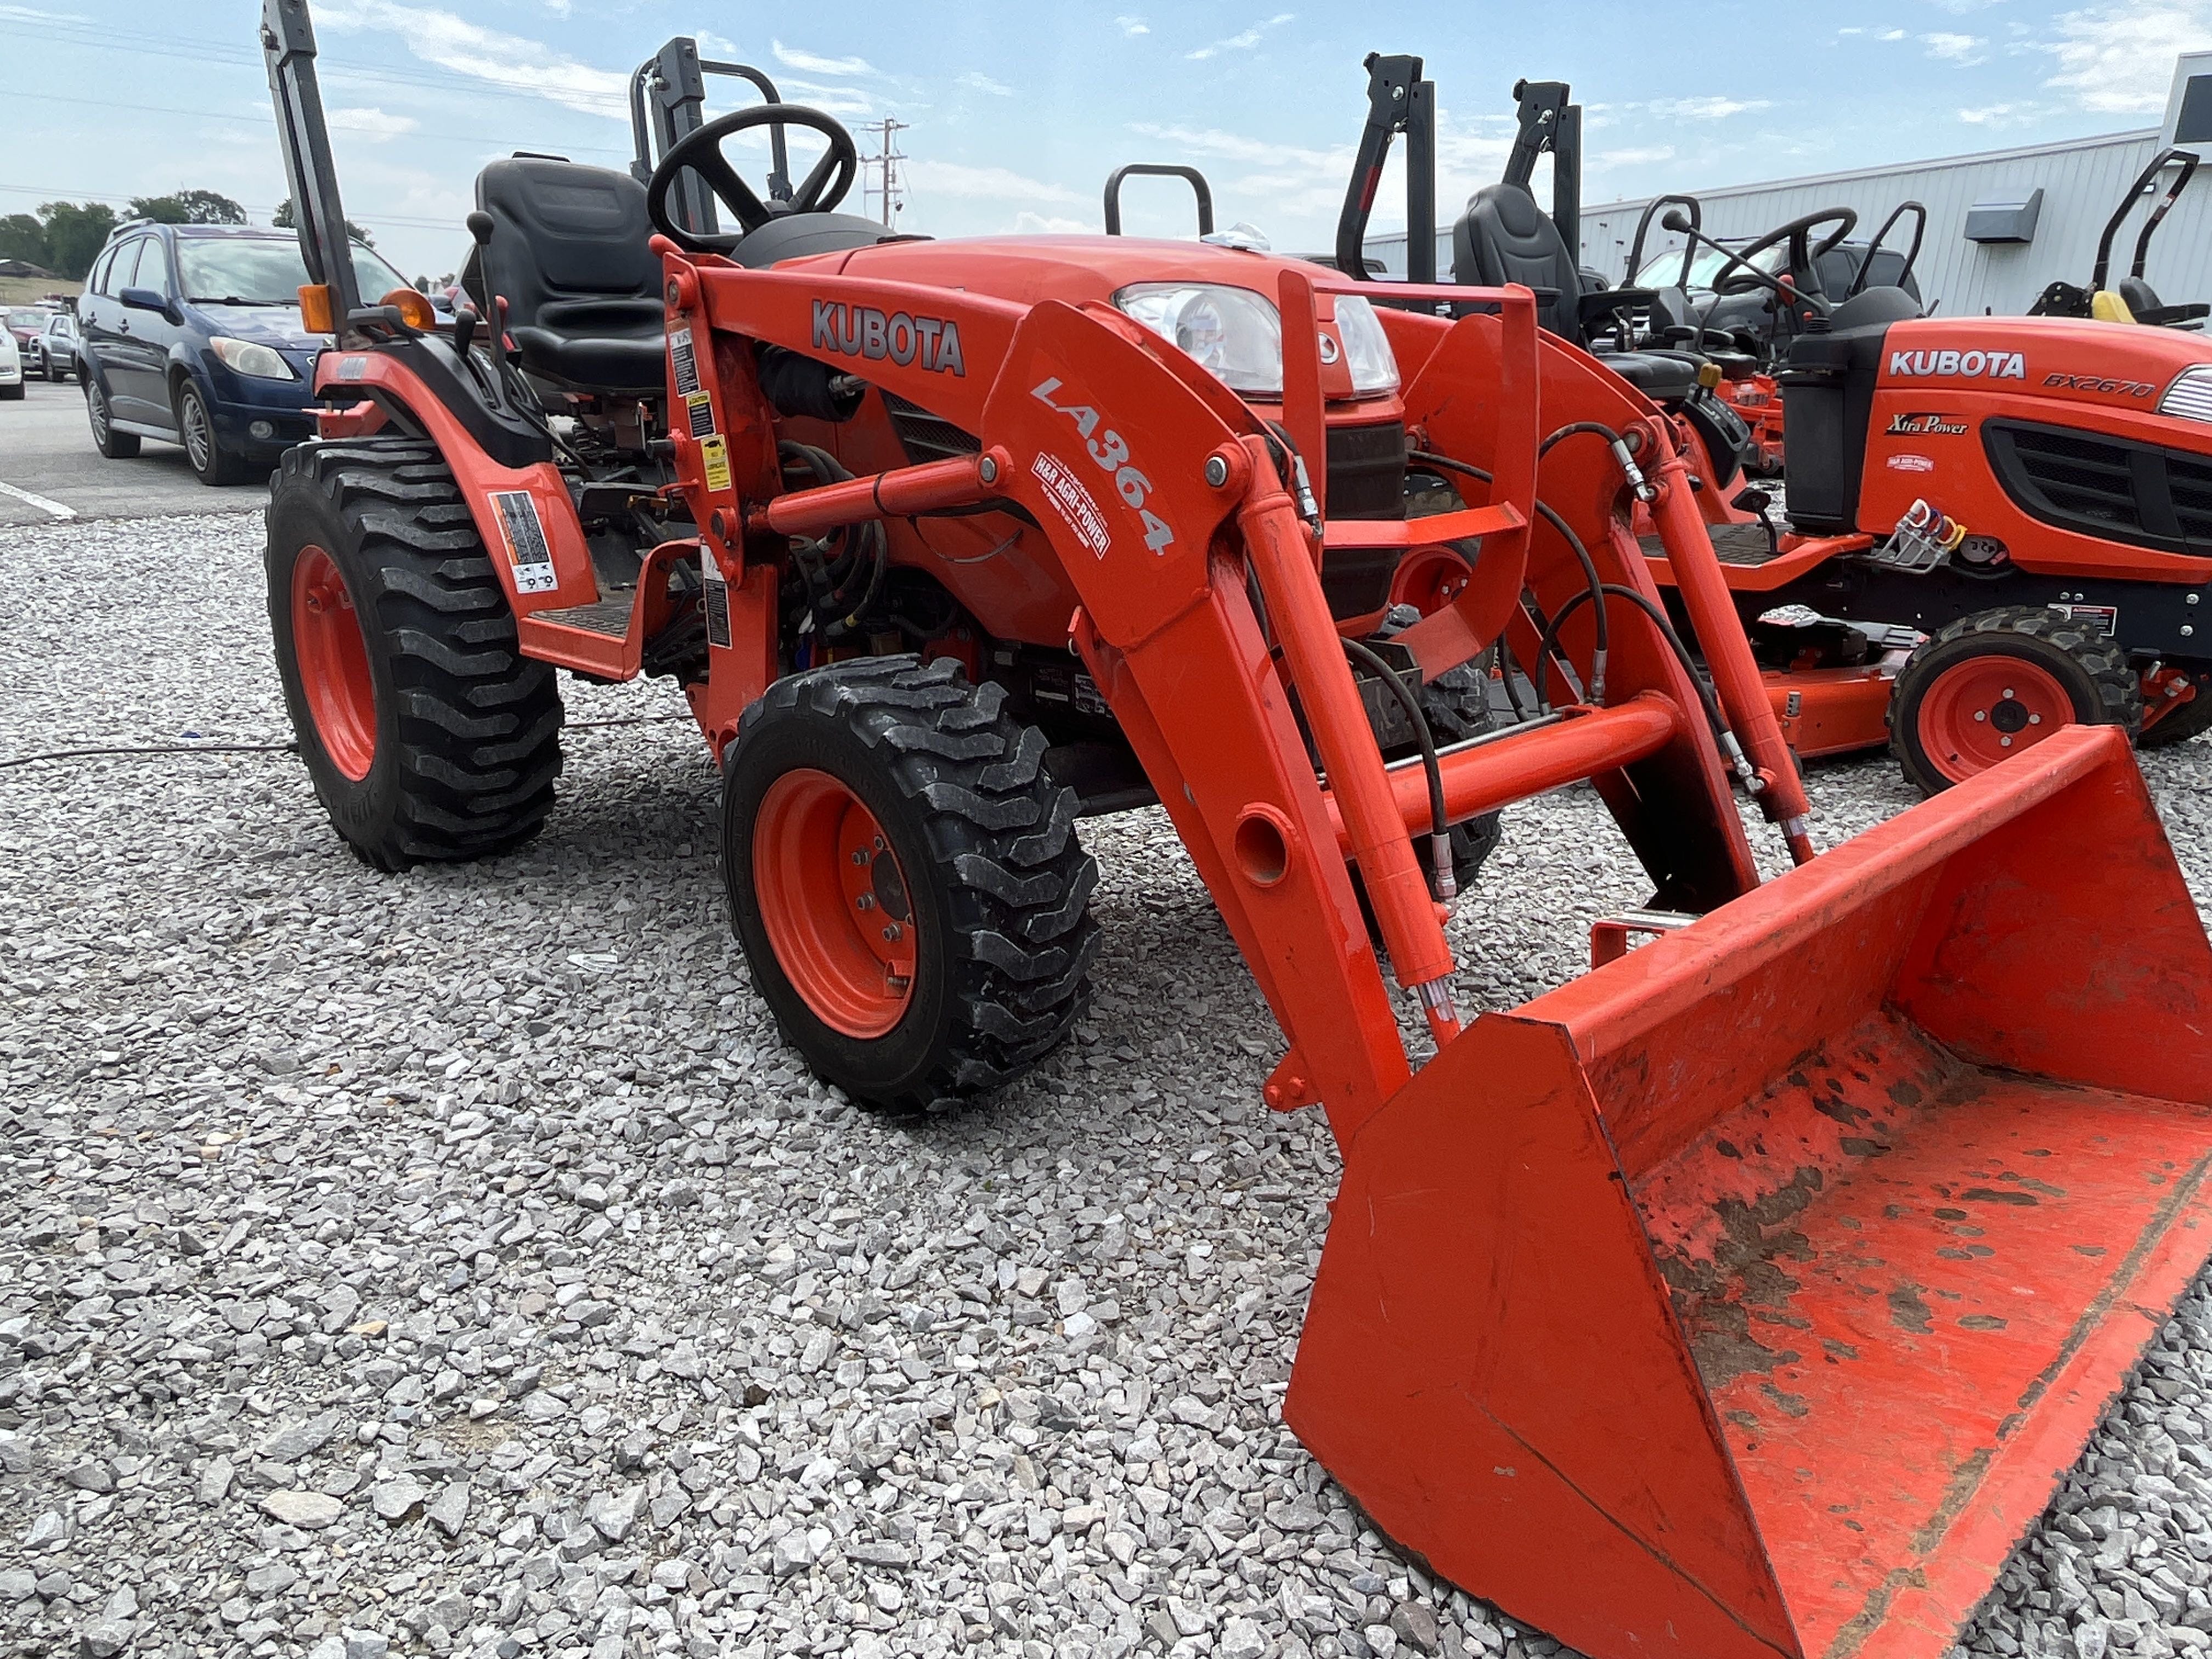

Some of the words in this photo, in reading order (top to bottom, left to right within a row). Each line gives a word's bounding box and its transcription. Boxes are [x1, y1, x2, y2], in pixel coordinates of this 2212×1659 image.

[812, 299, 966, 377] KUBOTA
[1888, 349, 2025, 379] KUBOTA
[2041, 373, 2157, 398] BX2670
[1887, 414, 1920, 433] Xtra
[1922, 415, 1968, 434] Power
[1030, 376, 1175, 556] LA364
[1035, 457, 1058, 484] H&R
[1054, 477, 1108, 554] AGRI-POWER
